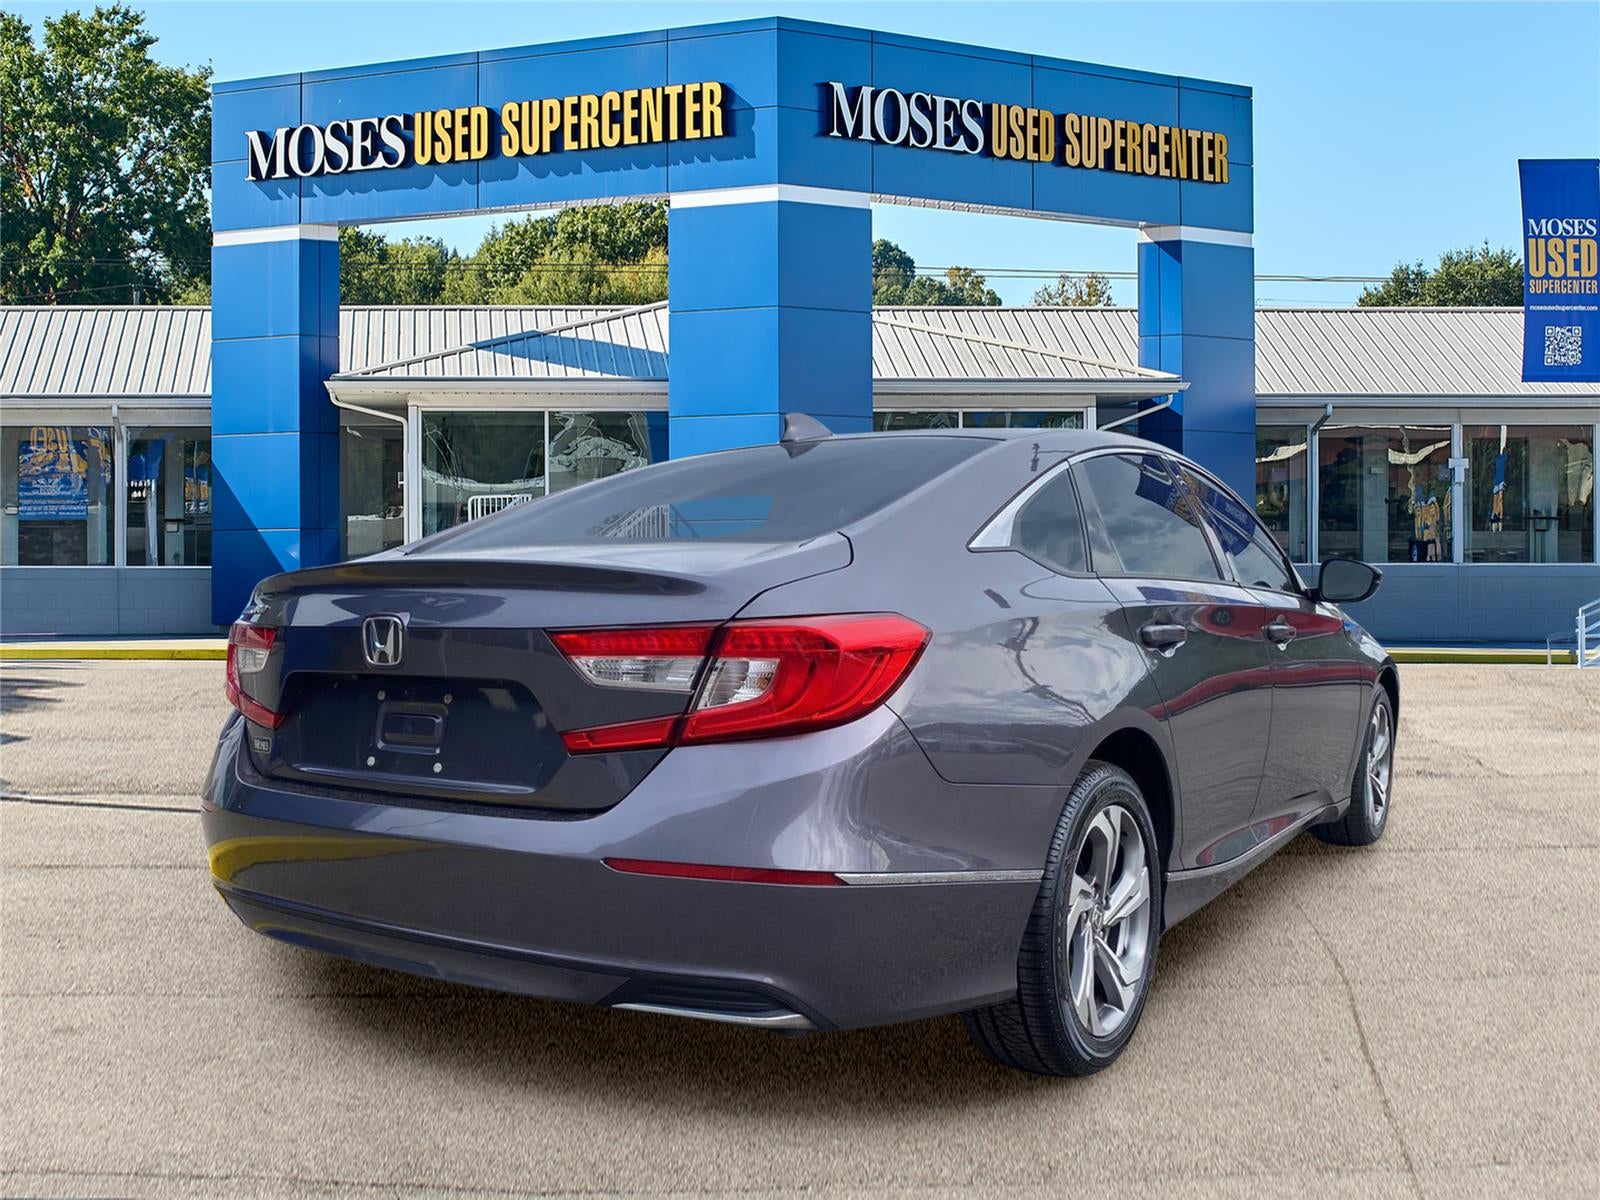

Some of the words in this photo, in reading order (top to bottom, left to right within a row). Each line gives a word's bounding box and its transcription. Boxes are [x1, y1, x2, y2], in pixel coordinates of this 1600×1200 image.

[244, 114, 406, 181] MOSES
[413, 106, 488, 165] USED
[501, 81, 723, 158] SUPERCENTER
[829, 81, 985, 154] MOSES
[991, 103, 1055, 162] USED
[1065, 112, 1229, 184] SUPERCENTER
[1528, 218, 1597, 237] MOSES
[1528, 238, 1598, 278] USED
[1529, 279, 1598, 294] SUPERCENTER
